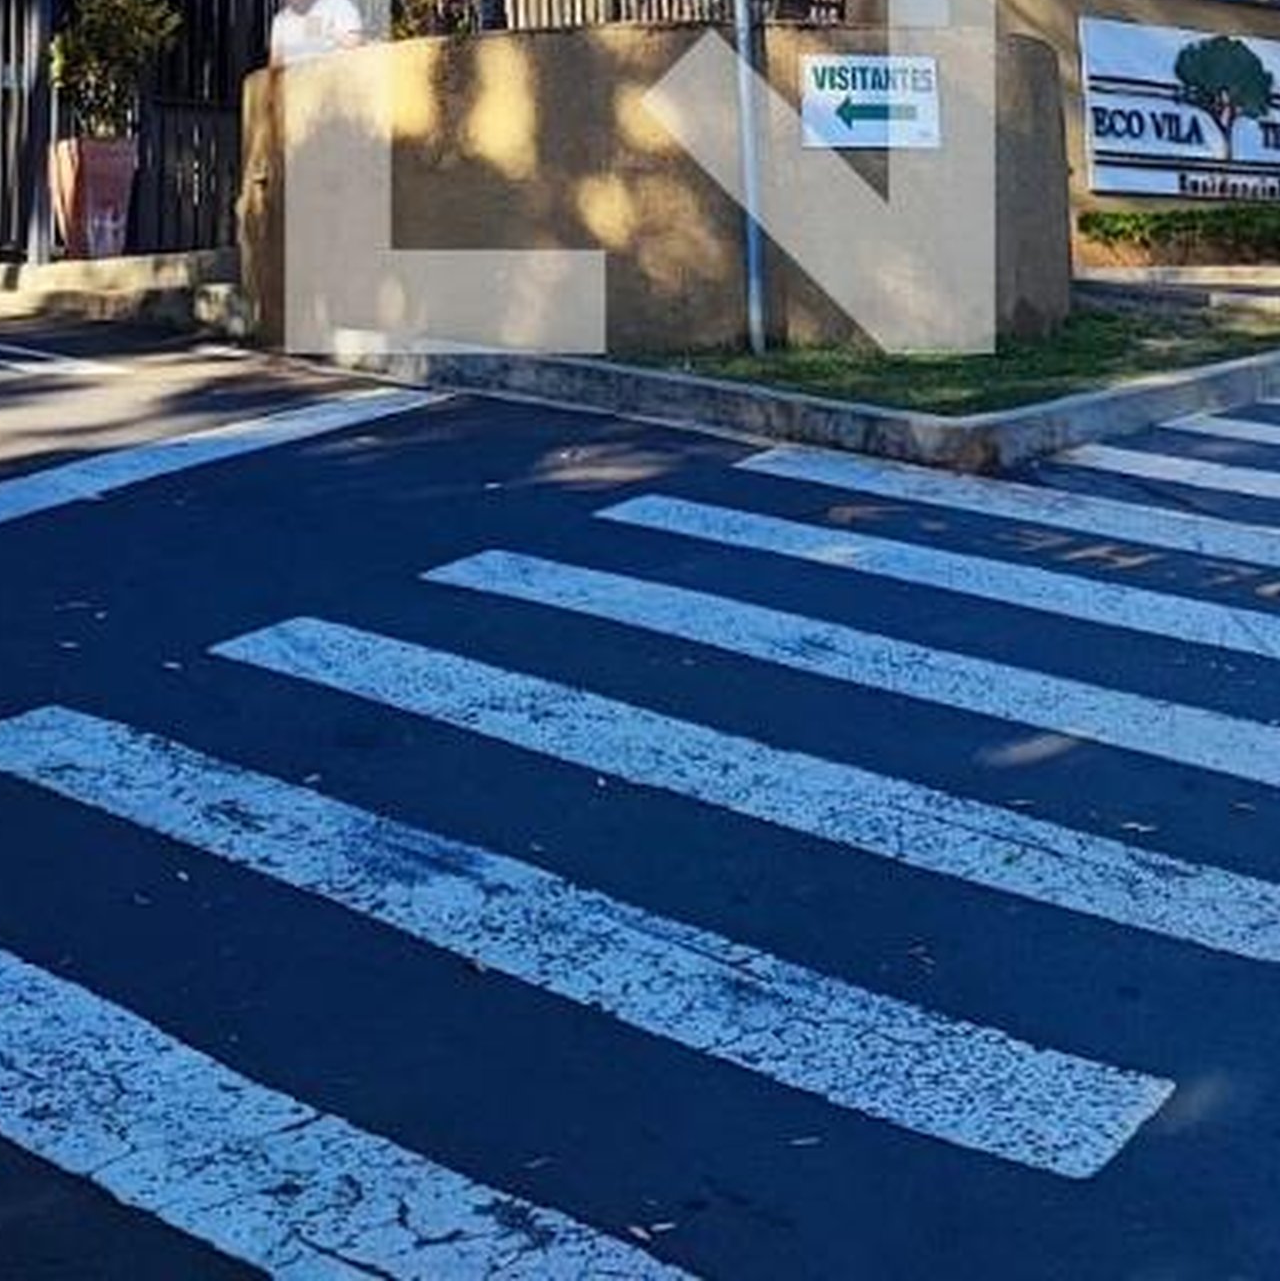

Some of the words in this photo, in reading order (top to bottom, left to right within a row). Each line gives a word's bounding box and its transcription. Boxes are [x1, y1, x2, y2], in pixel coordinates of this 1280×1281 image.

[813, 65, 934, 93] VISITANTES
[1091, 106, 1145, 138] ECO
[1149, 111, 1205, 145] VILA
